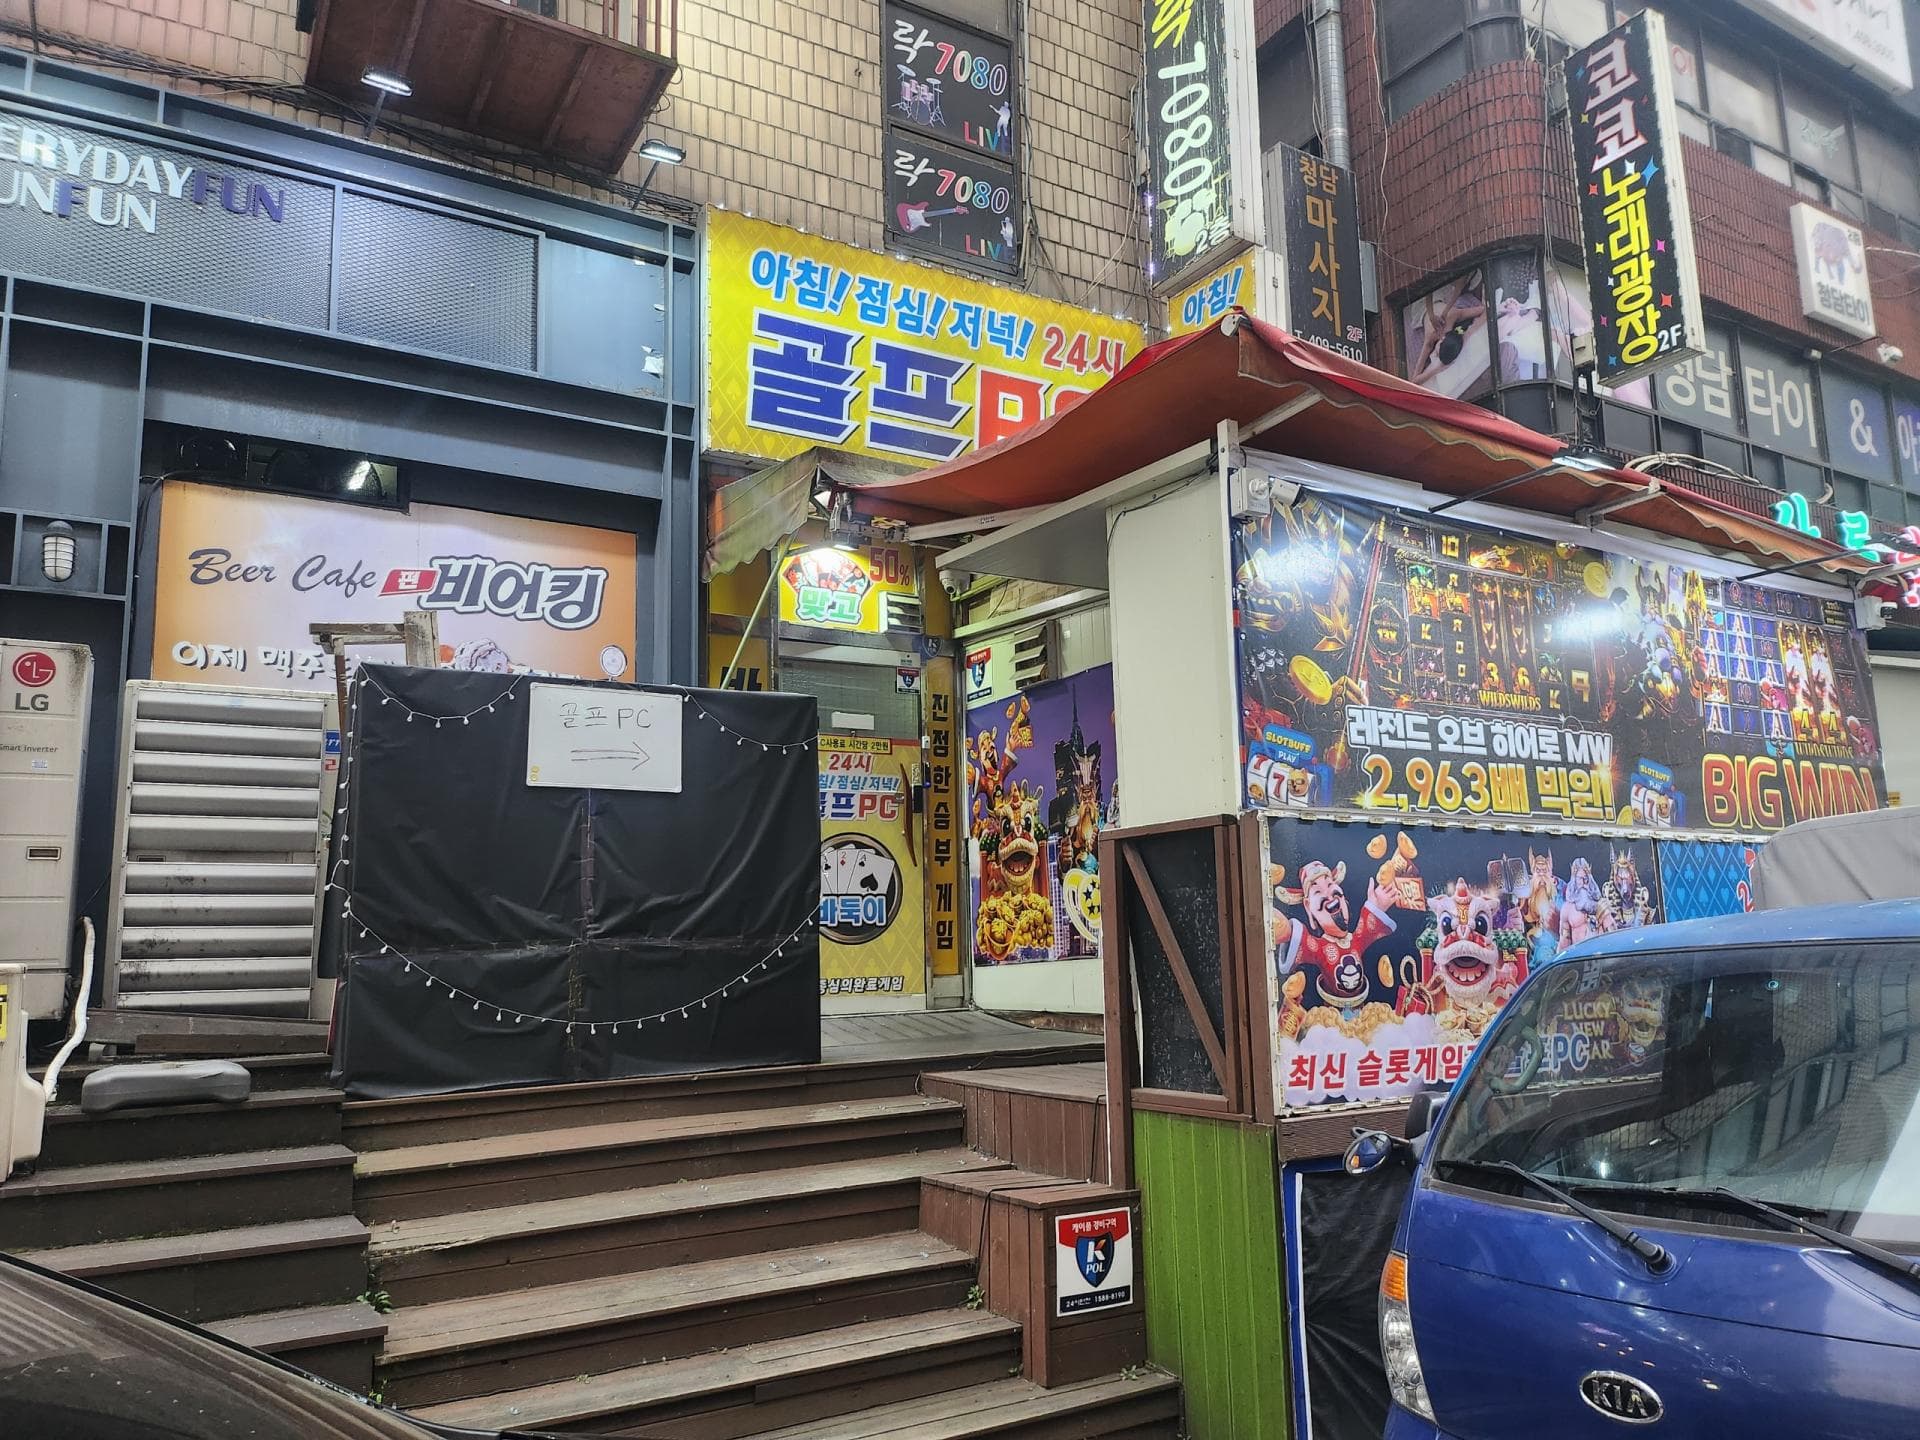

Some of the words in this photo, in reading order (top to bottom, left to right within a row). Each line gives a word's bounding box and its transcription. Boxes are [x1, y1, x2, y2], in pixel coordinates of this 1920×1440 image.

[893, 20, 934, 63] 락
[935, 42, 1008, 95] 7080
[1584, 37, 1649, 173] 코코
[894, 150, 935, 186] 락
[936, 169, 1009, 214] 7080
[1299, 156, 1338, 195] 청담
[1306, 195, 1342, 337] 마사지
[1603, 167, 1660, 365] 노래광장
[1657, 324, 1682, 352] 2F
[189, 549, 276, 585] Beer
[292, 555, 377, 598] Cafe
[798, 588, 859, 622] 맞고
[172, 640, 247, 673] 이제
[15, 693, 49, 711] LG
[560, 703, 607, 729] 골프
[617, 709, 651, 729] PC
[1265, 731, 1312, 753] SLOTBUFF
[1349, 707, 1432, 752] 레전드
[1438, 718, 1487, 757] 오브
[1491, 724, 1561, 762] 히어로
[829, 754, 872, 772] 24시
[1278, 750, 1297, 763] PLAY
[1364, 753, 1531, 815] 2,963배
[1703, 753, 1785, 831] BIG
[1783, 759, 1878, 824] WIN
[1563, 1001, 1613, 1022] LUCKY
[1288, 1053, 1347, 1091] 최신
[1086, 1262, 1105, 1275] POL
[1592, 1379, 1648, 1417] KIA
